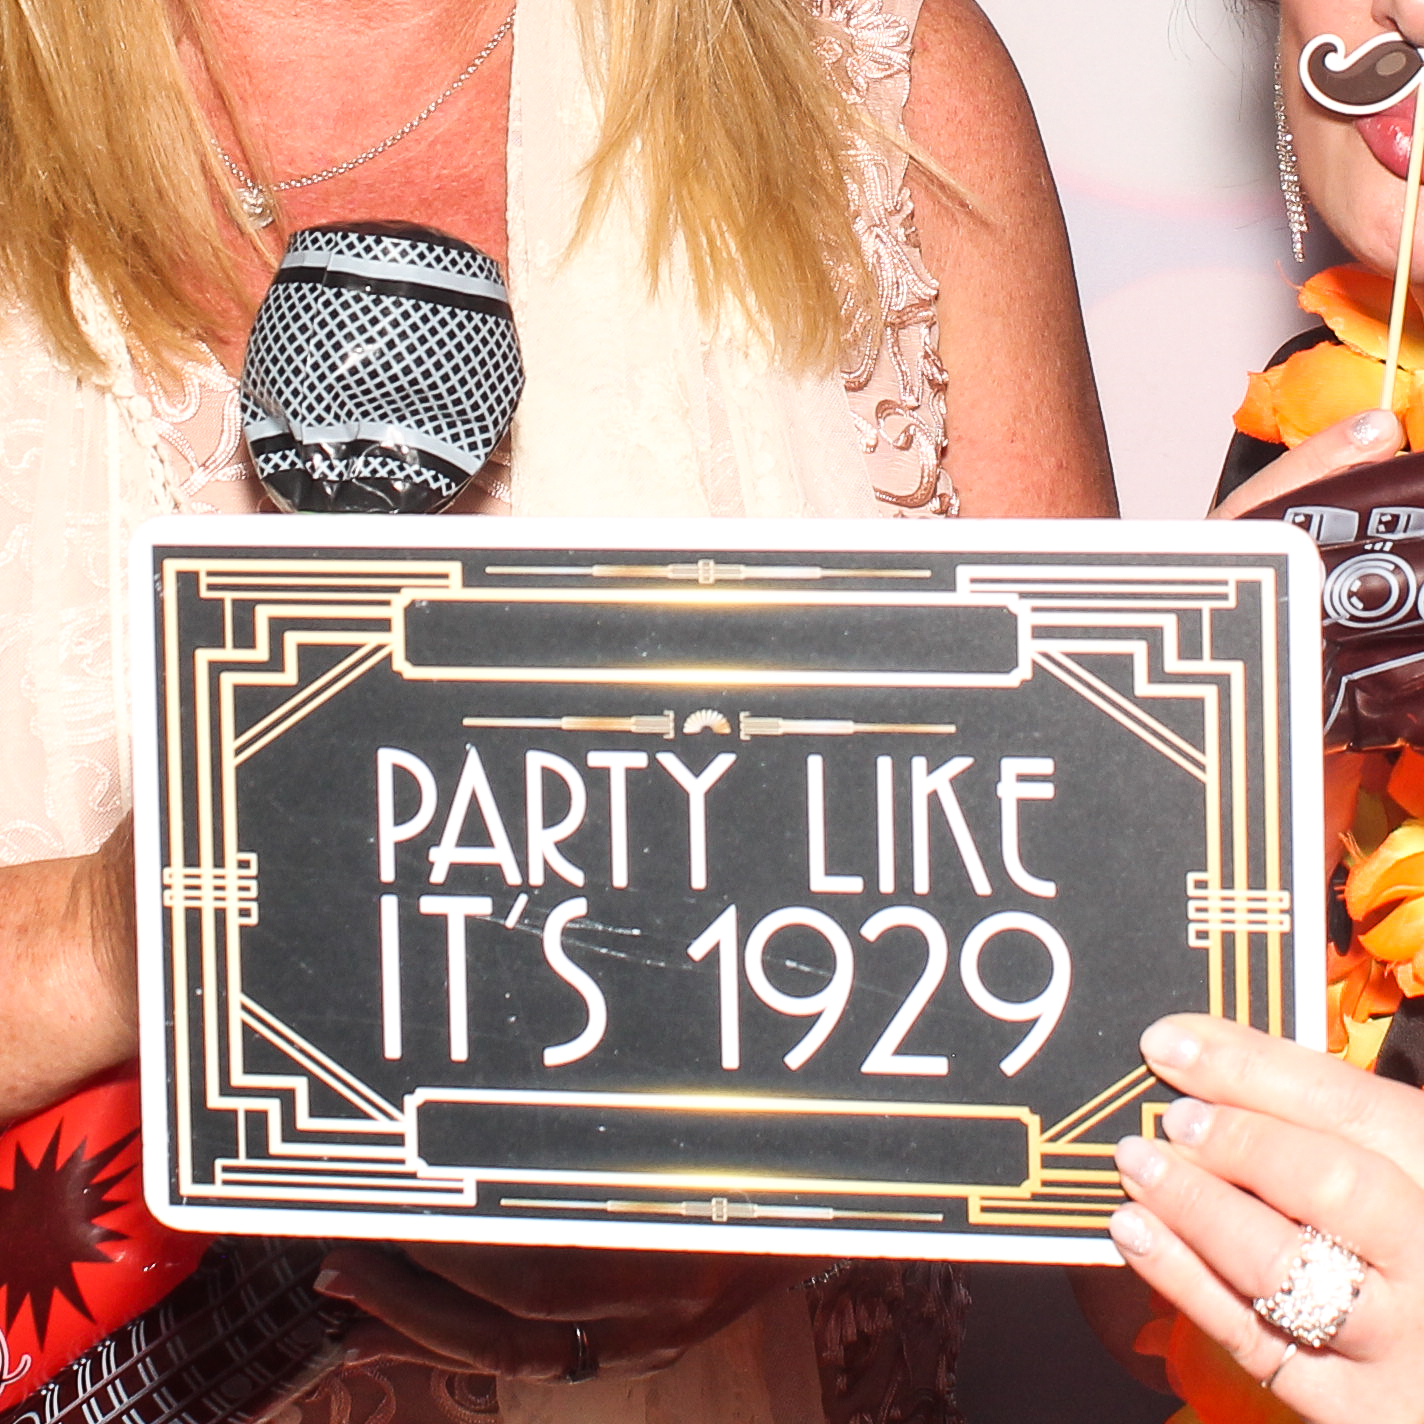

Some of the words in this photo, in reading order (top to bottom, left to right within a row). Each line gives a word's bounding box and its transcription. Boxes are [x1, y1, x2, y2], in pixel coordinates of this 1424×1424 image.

[376, 746, 737, 890] PARTY
[806, 753, 1058, 899] LIKE
[379, 892, 608, 1067] IT'S
[686, 904, 1072, 1077] 1929
